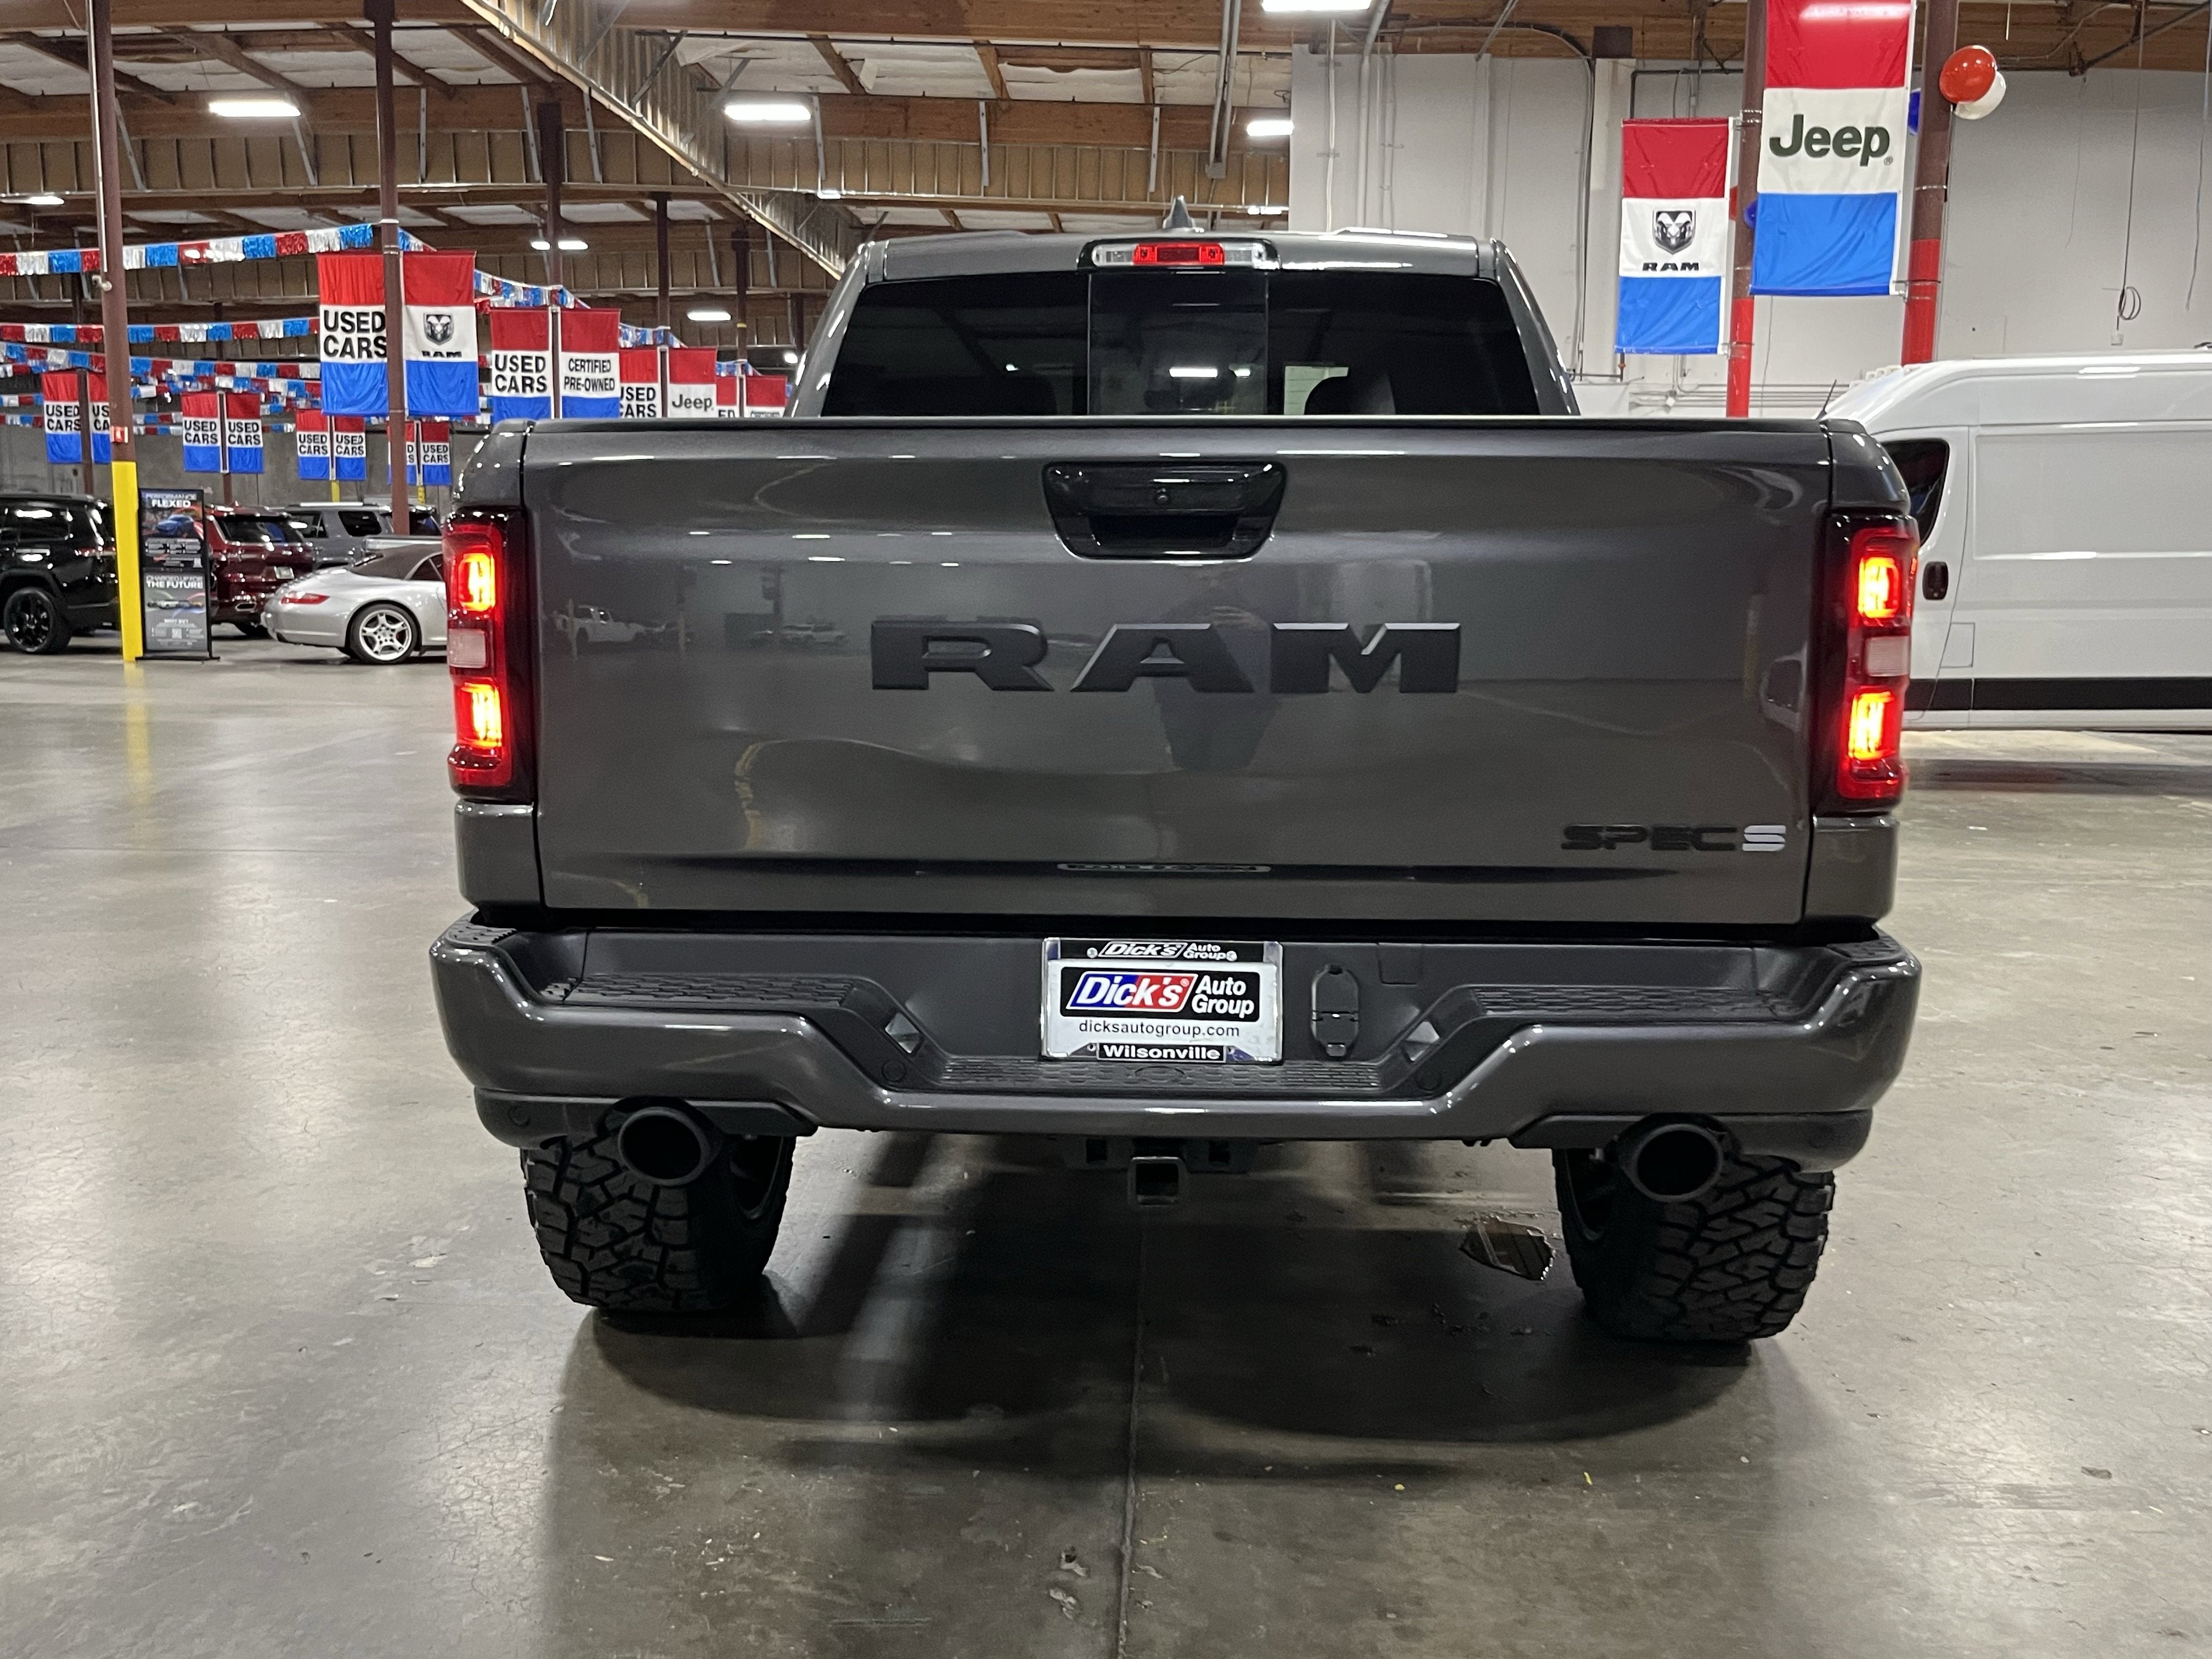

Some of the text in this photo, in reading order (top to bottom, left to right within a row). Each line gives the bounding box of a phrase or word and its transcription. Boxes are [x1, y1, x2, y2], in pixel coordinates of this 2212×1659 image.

[1769, 114, 1890, 166] Jeep
[1642, 262, 1700, 272] RAM
[324, 310, 385, 334] USED
[324, 335, 386, 359] CARS
[495, 354, 546, 373] USED
[568, 358, 611, 373] CERTIFIED
[495, 374, 548, 393] CARS
[564, 376, 615, 392] PRE-OWNED
[672, 394, 712, 411] Jeep
[46, 404, 80, 417] USED
[47, 419, 81, 431] CARS
[184, 420, 217, 432] USED
[228, 421, 259, 433] USED
[185, 433, 218, 444] CARS
[228, 434, 261, 445] CARS
[299, 434, 328, 444] USED
[336, 435, 363, 445] USED
[299, 445, 328, 455] CARS
[336, 446, 364, 456] CARS
[423, 444, 448, 453] USED
[423, 454, 449, 464] CARS
[152, 499, 191, 508] FLEXED
[871, 621, 1461, 693] RAM
[1104, 943, 1178, 957] Dick's
[1186, 943, 1221, 952] Auto
[1183, 951, 1227, 961] Group
[1076, 975, 1183, 1007] Dick's
[1195, 975, 1246, 996] Auto
[1191, 994, 1255, 1019] Group
[1079, 1020, 1240, 1037] dicksautogroup.com
[1103, 1045, 1221, 1060] Wilsonville
